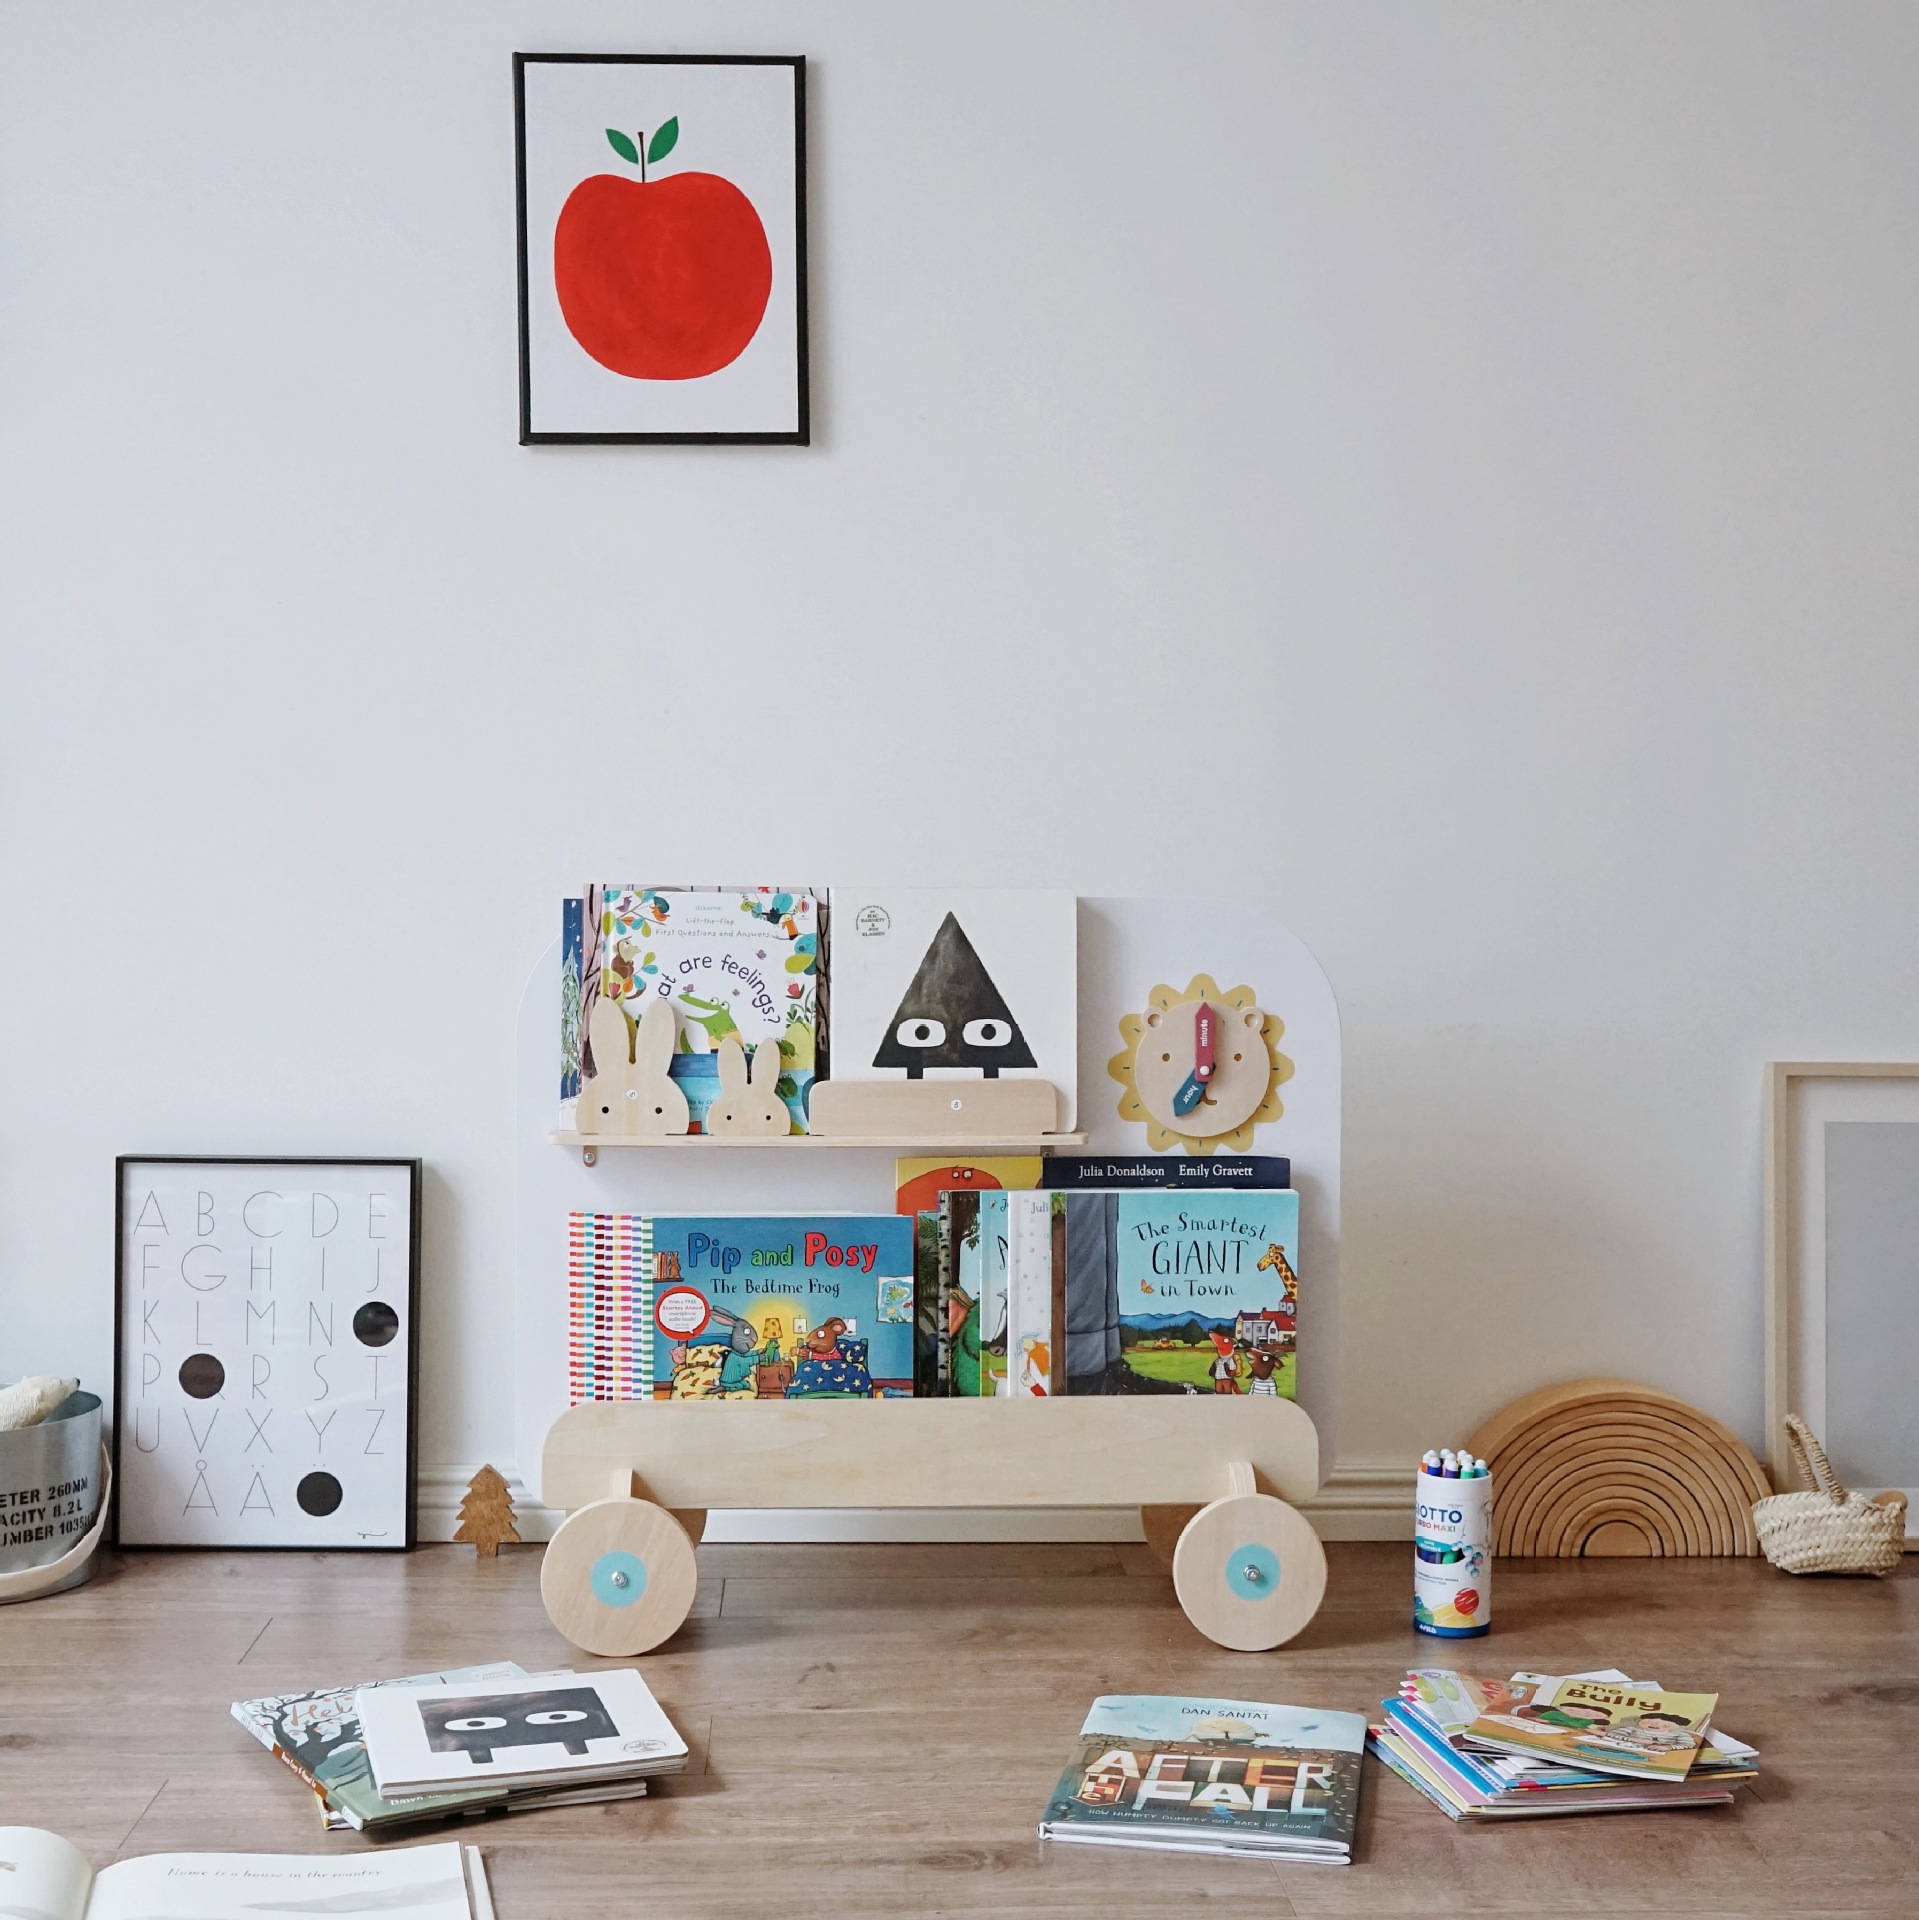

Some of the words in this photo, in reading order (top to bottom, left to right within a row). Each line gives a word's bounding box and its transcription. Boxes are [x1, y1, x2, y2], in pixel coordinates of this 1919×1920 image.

[677, 929, 716, 938] Questions
[736, 930, 770, 938] Answers
[658, 972, 677, 999] at
[679, 955, 713, 974] are
[721, 954, 781, 1024] feelings?
[1200, 1019, 1209, 1047] minute
[1183, 1085, 1199, 1104] hour
[1078, 1165, 1103, 1178] Julia
[1107, 1164, 1165, 1177] Donaldson
[1178, 1164, 1210, 1178] Emily
[1212, 1164, 1253, 1177] Gravett
[133, 1189, 169, 1236] A
[197, 1190, 215, 1237] B
[242, 1190, 284, 1239] C
[312, 1192, 339, 1238] D
[368, 1193, 387, 1239] E
[1131, 1221, 1170, 1242] The
[1177, 1211, 1267, 1242] Smartest
[687, 1232, 742, 1274] Pip
[750, 1243, 794, 1267] and
[804, 1231, 878, 1274] Posy
[1152, 1239, 1250, 1275] GIANT
[142, 1244, 161, 1290] F
[181, 1244, 227, 1292] G
[250, 1245, 272, 1291] H
[366, 1247, 380, 1293] J
[710, 1278, 738, 1294] The
[745, 1278, 803, 1294] Bedtime
[808, 1278, 841, 1298] Frog
[1160, 1281, 1181, 1297] in
[1183, 1279, 1238, 1297] Town
[143, 1299, 162, 1345] K
[196, 1300, 213, 1346] L
[245, 1300, 275, 1346] M
[309, 1301, 333, 1347] N
[142, 1353, 162, 1399] P
[252, 1354, 271, 1400] R
[313, 1354, 329, 1401] S
[365, 1355, 388, 1400] T
[135, 1407, 161, 1453] U
[183, 1407, 220, 1454] V
[244, 1408, 273, 1454] X
[304, 1409, 337, 1454] Y
[363, 1409, 385, 1455] Z
[48, 1476, 88, 1501] 260MM
[182, 1459, 219, 1517] Å
[239, 1464, 275, 1517] Ä
[1416, 1502, 1463, 1524] IOTTO
[1433, 1523, 1456, 1533] MAXI
[1565, 1688, 1662, 1712] Bully
[1578, 1683, 1622, 1694] The
[1181, 1707, 1211, 1716] DAN
[1217, 1710, 1270, 1720] SANTAT
[1084, 1749, 1335, 1790] AFTER
[1131, 1778, 1328, 1815] FALL
[1112, 1811, 1158, 1819] HUMPTY
